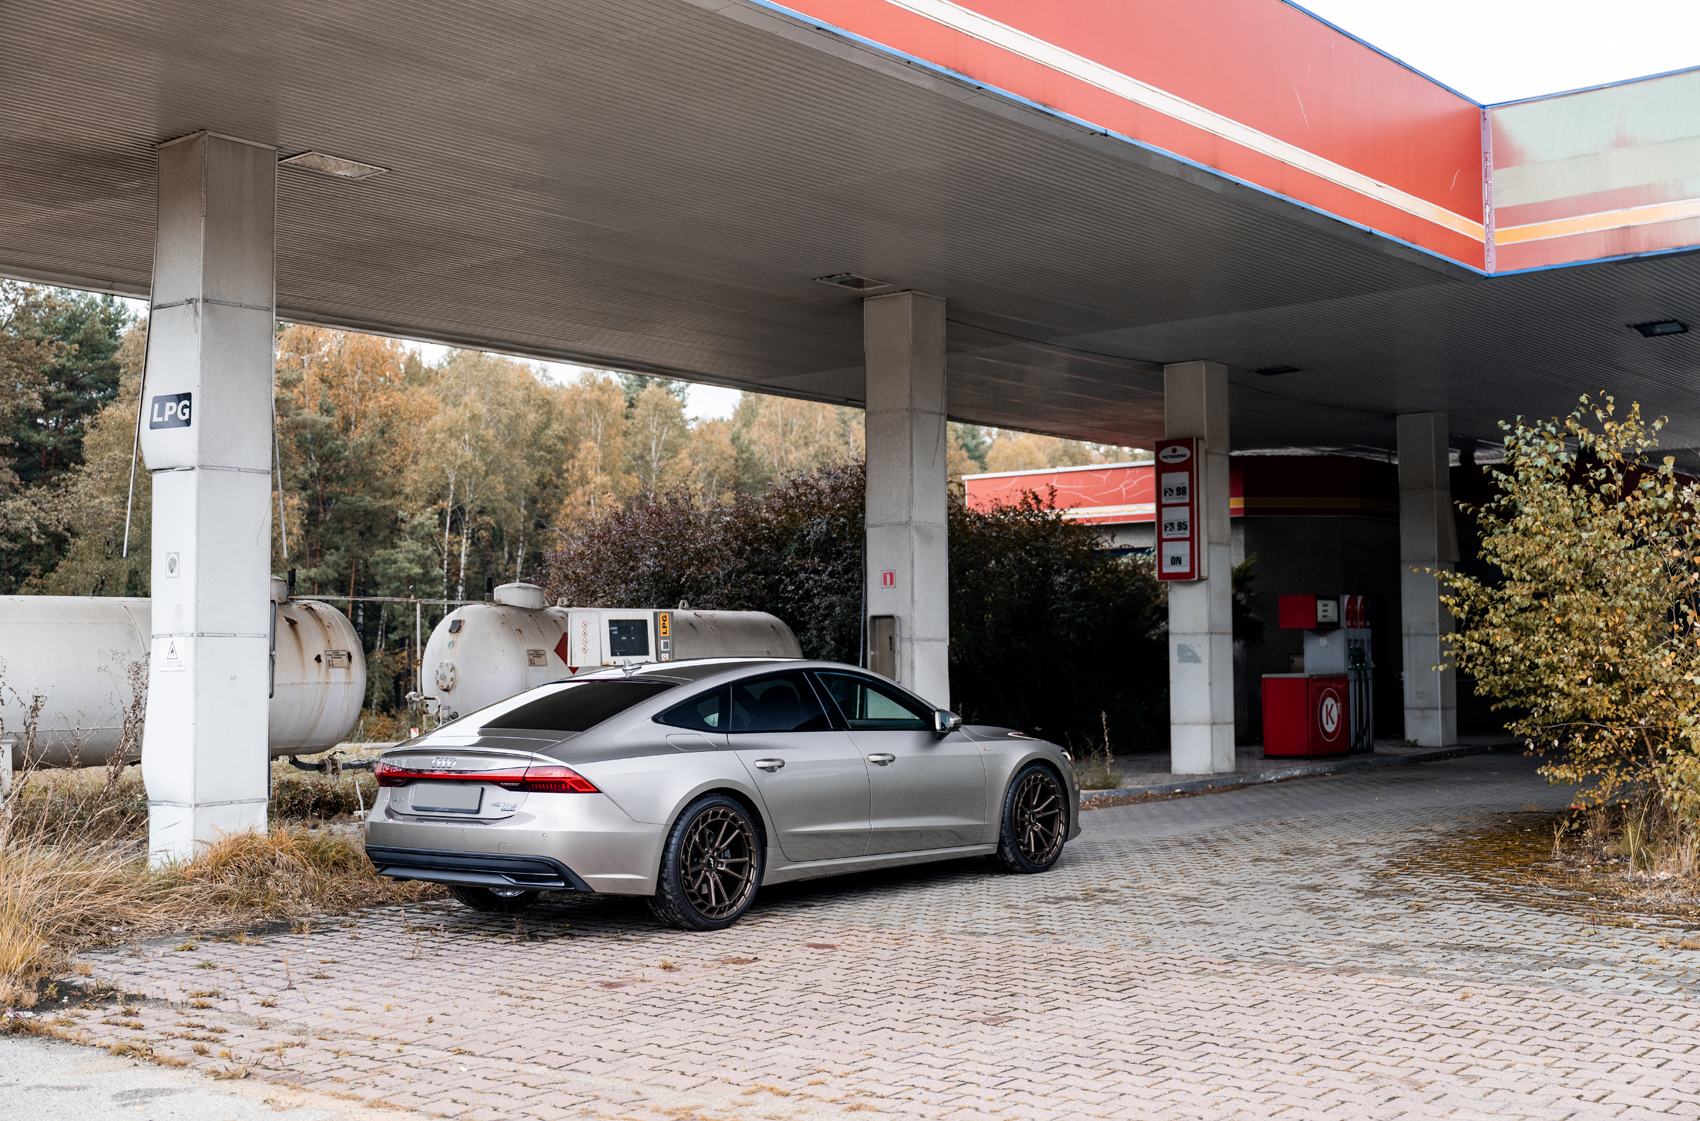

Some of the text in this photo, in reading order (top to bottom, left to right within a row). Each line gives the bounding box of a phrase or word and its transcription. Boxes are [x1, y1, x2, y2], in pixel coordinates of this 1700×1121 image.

[152, 400, 190, 422] LPG
[1175, 486, 1187, 497] 98
[1176, 521, 1188, 531] 95
[1170, 556, 1182, 566] ON
[1325, 703, 1335, 726] K
